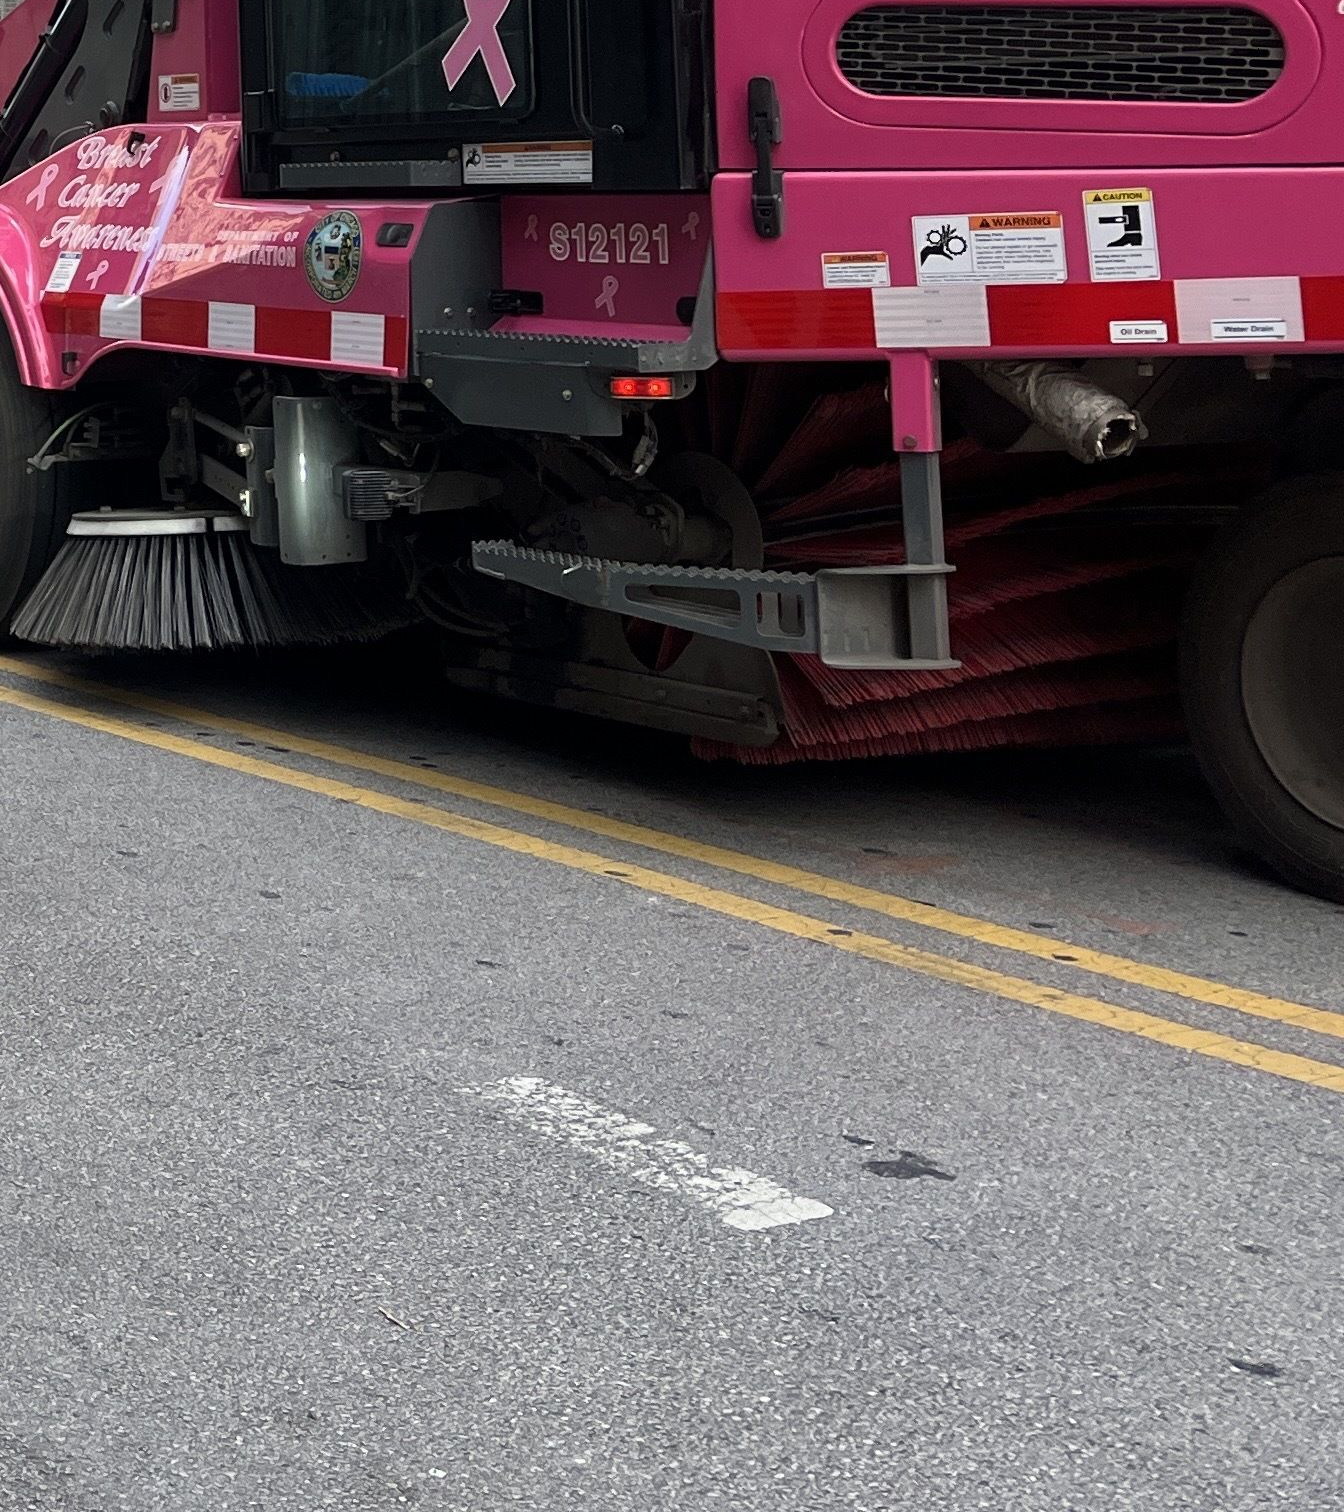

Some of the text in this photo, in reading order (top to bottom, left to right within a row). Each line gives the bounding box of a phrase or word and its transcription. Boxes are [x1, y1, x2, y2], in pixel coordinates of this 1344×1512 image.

[76, 135, 162, 170] Breast
[57, 174, 141, 208] Cancer
[1102, 192, 1143, 202] CAUTION
[992, 216, 1052, 228] WARNING
[283, 231, 299, 242] OF
[549, 222, 669, 265] S12121
[1120, 327, 1157, 336] Oil Drain
[1250, 325, 1275, 333] Drain
